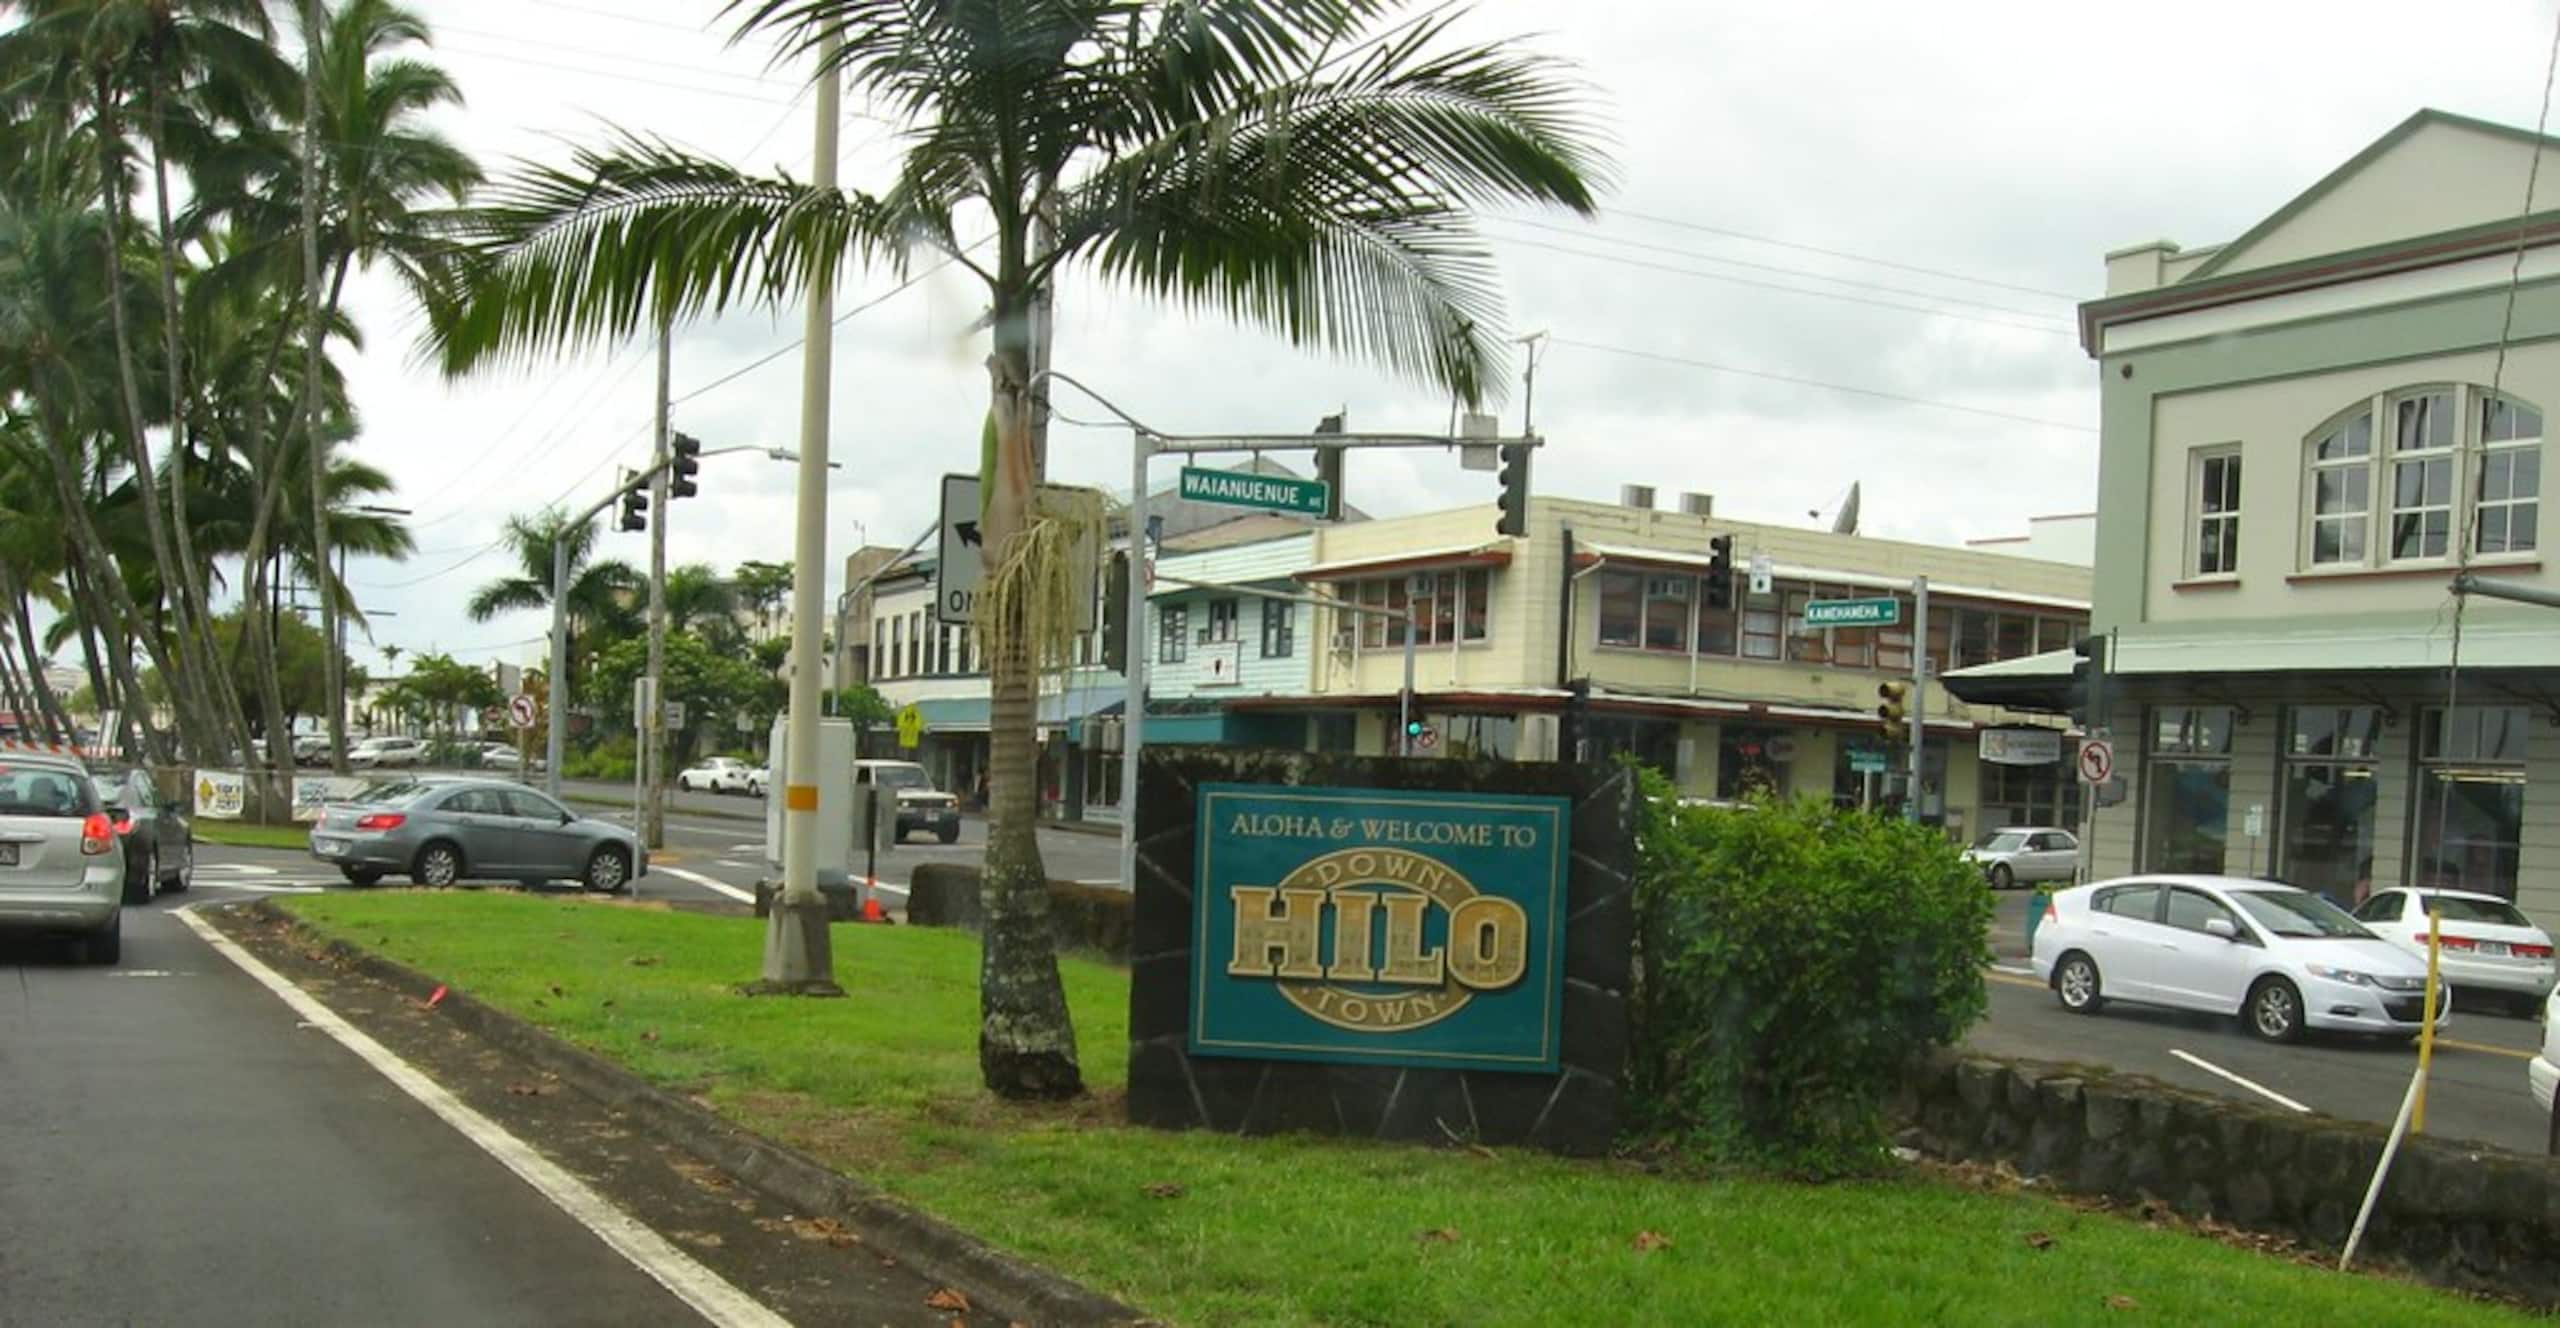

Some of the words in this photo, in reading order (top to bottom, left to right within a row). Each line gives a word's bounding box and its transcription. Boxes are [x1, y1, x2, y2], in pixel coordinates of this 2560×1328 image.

[1185, 475, 1299, 504] WAIANUENUE
[1231, 813, 1324, 838] ALOHA
[1330, 817, 1353, 839] &
[1361, 819, 1491, 846] WELCOME
[1501, 824, 1537, 848] TO
[1316, 855, 1444, 892] DOWN
[1227, 885, 1528, 989] HILO
[1317, 986, 1438, 1023] TOWN
